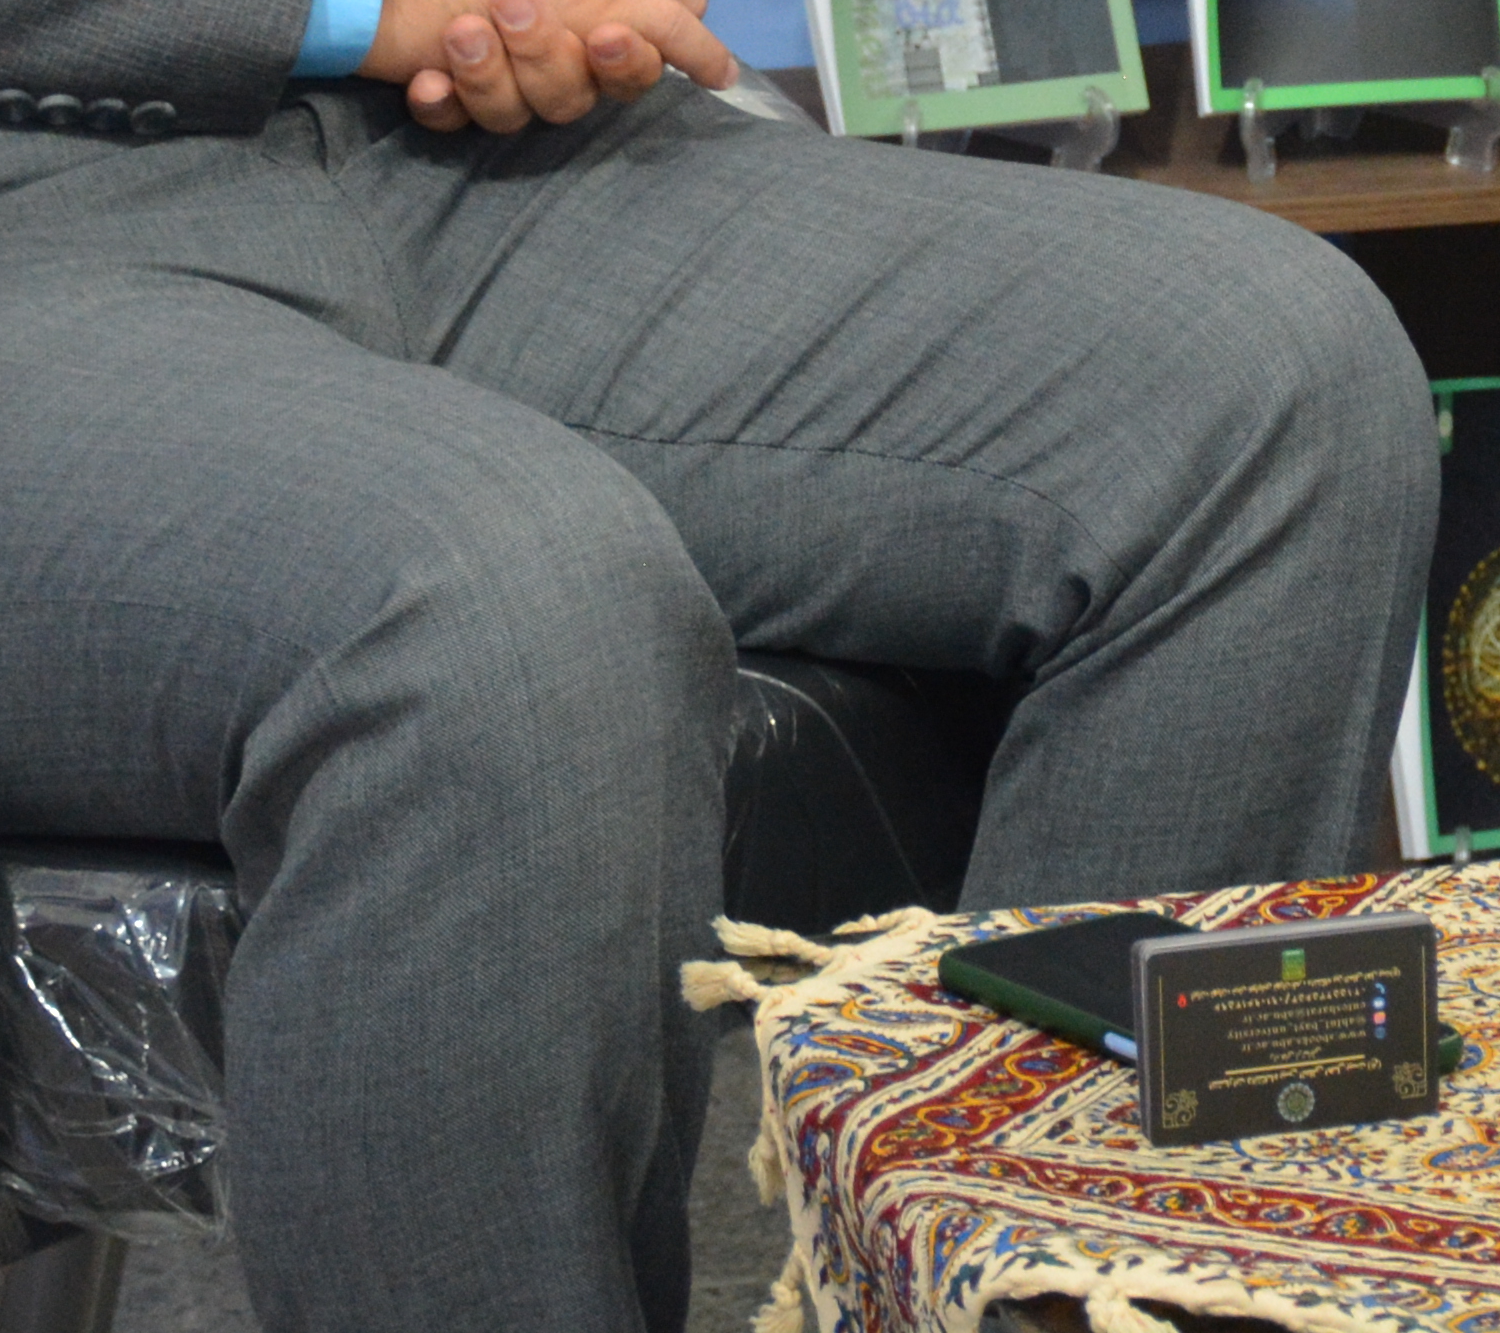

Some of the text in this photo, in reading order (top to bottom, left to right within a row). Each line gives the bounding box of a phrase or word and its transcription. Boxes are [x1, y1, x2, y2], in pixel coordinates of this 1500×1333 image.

[1209, 1074, 1245, 1090] انتشارات
[1247, 1069, 1279, 1086] دانشگاه
[1279, 1067, 1298, 1082] بین
[1299, 1064, 1324, 1082] المللی
[1324, 1061, 1344, 1078] اهل
[1344, 1059, 1367, 1074] بیت
